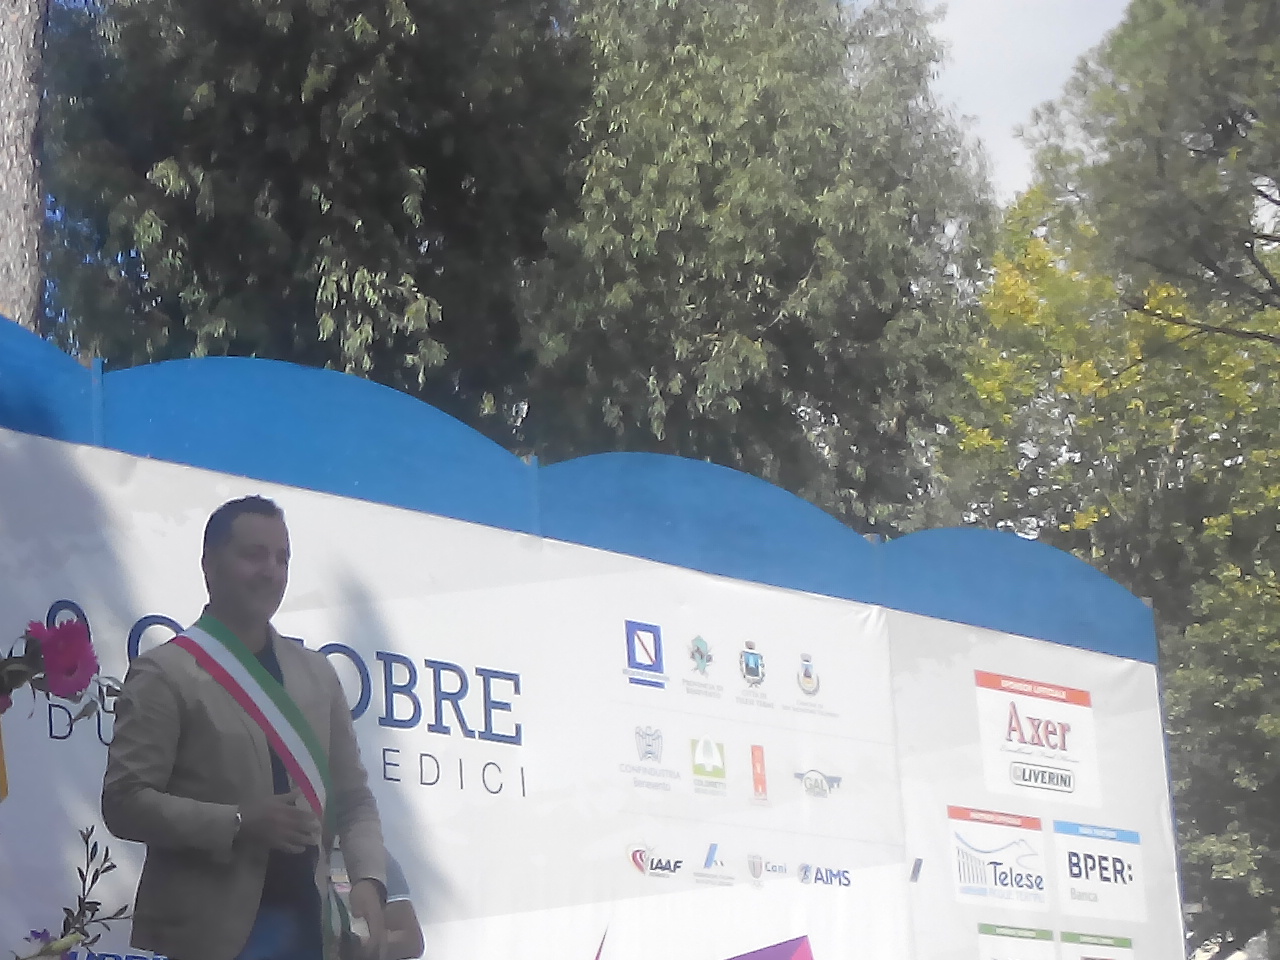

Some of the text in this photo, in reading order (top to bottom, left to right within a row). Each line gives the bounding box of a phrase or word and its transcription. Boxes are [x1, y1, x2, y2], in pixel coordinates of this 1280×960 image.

[1005, 701, 1071, 751] Axer
[1022, 767, 1071, 788] LIVERINI
[649, 858, 683, 873] IAAF
[987, 861, 1044, 891] Telese
[814, 867, 851, 887] AIMS
